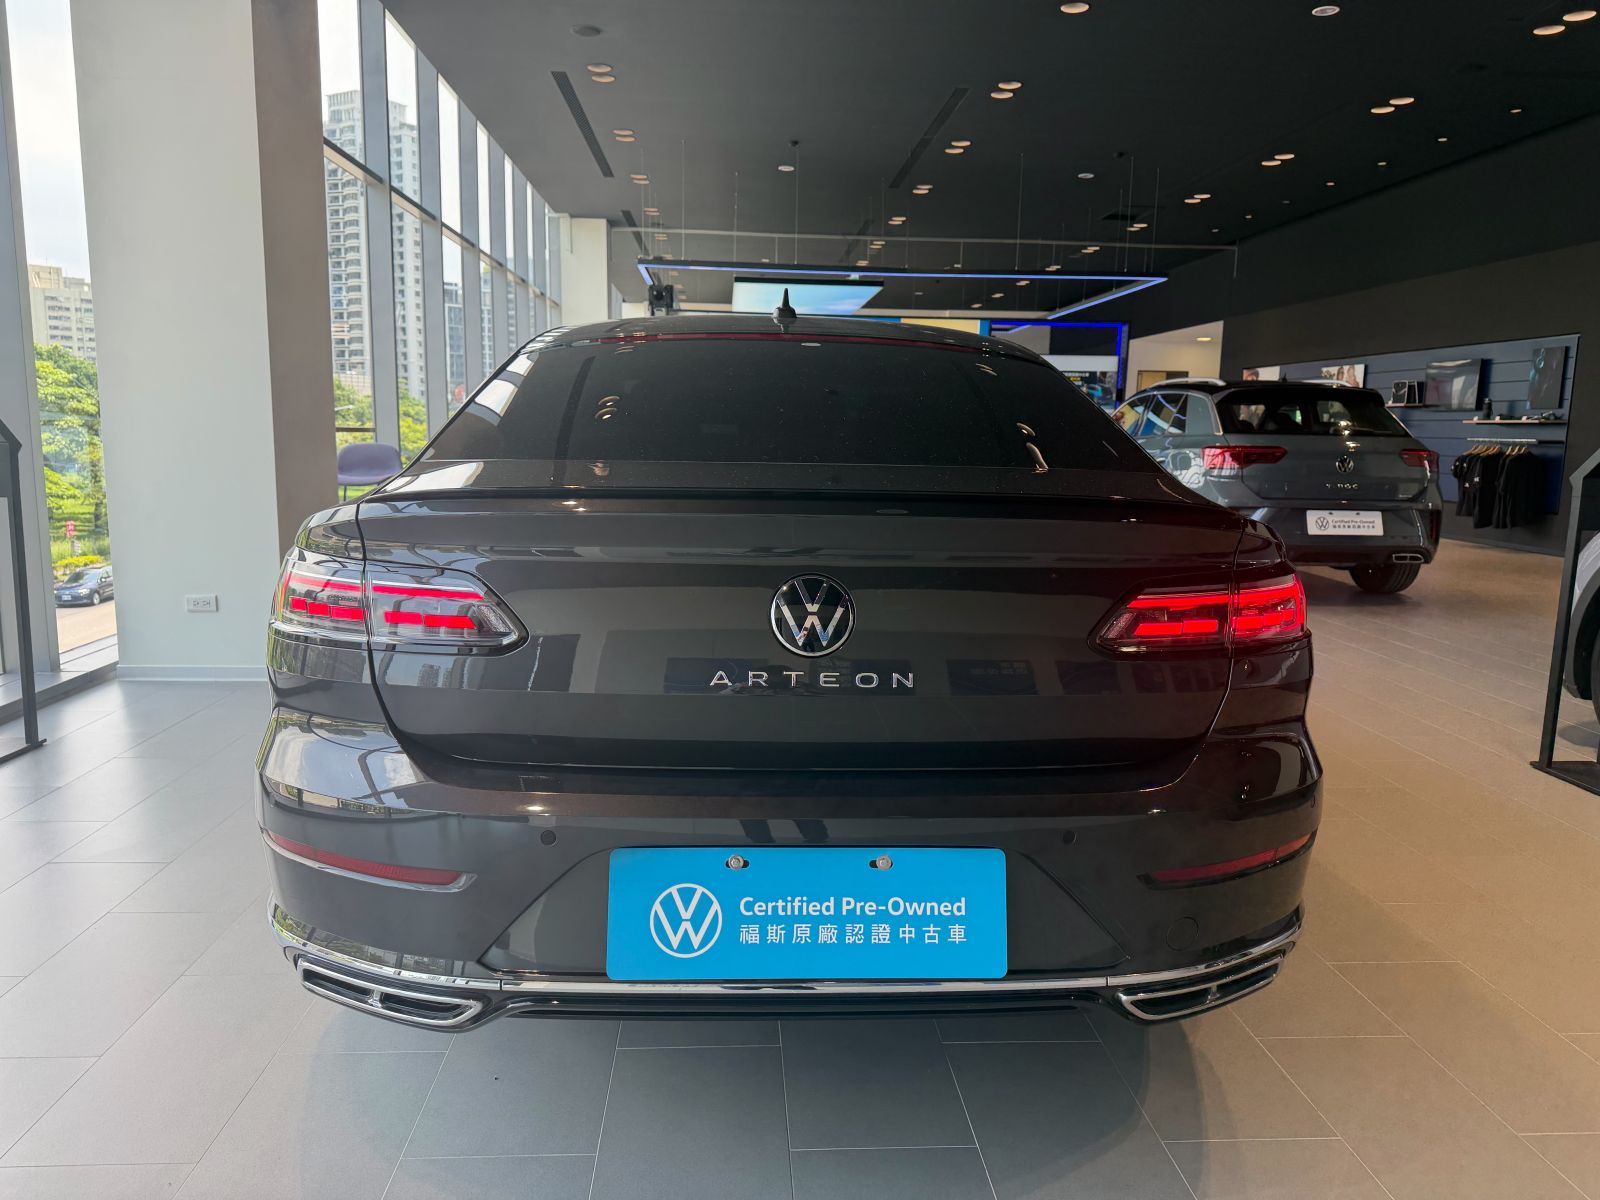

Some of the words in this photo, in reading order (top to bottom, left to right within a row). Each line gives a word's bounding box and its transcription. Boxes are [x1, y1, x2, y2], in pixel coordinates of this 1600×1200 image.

[770, 573, 855, 657] VW
[709, 670, 914, 688] ARTEON
[739, 896, 833, 916] Certified
[842, 897, 966, 916] Pre-Owned
[649, 883, 722, 958] VW
[739, 923, 967, 945] 福斯原廠認證中古車
